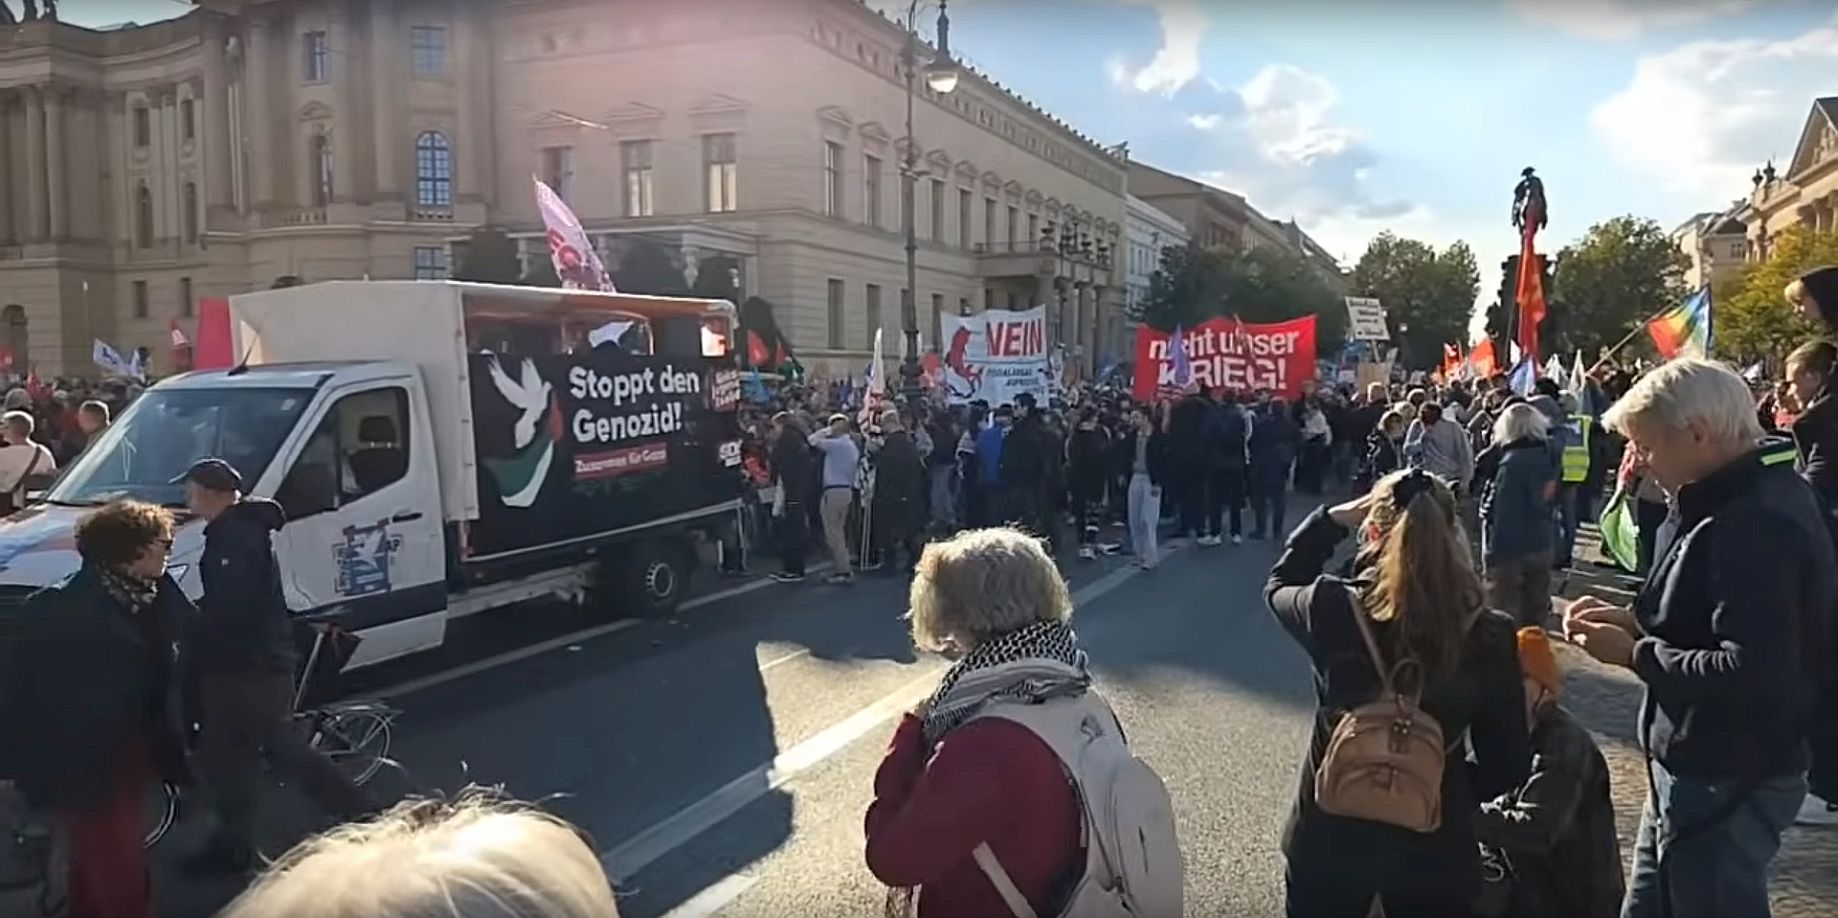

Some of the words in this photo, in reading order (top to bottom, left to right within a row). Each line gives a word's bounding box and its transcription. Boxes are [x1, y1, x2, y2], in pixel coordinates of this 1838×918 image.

[986, 318, 1042, 357] NEIN
[1219, 331, 1300, 356] unser
[569, 365, 655, 406] Stoppt
[659, 364, 699, 394] den
[1157, 355, 1288, 391] KRIEG!
[573, 402, 683, 443] Genozid!
